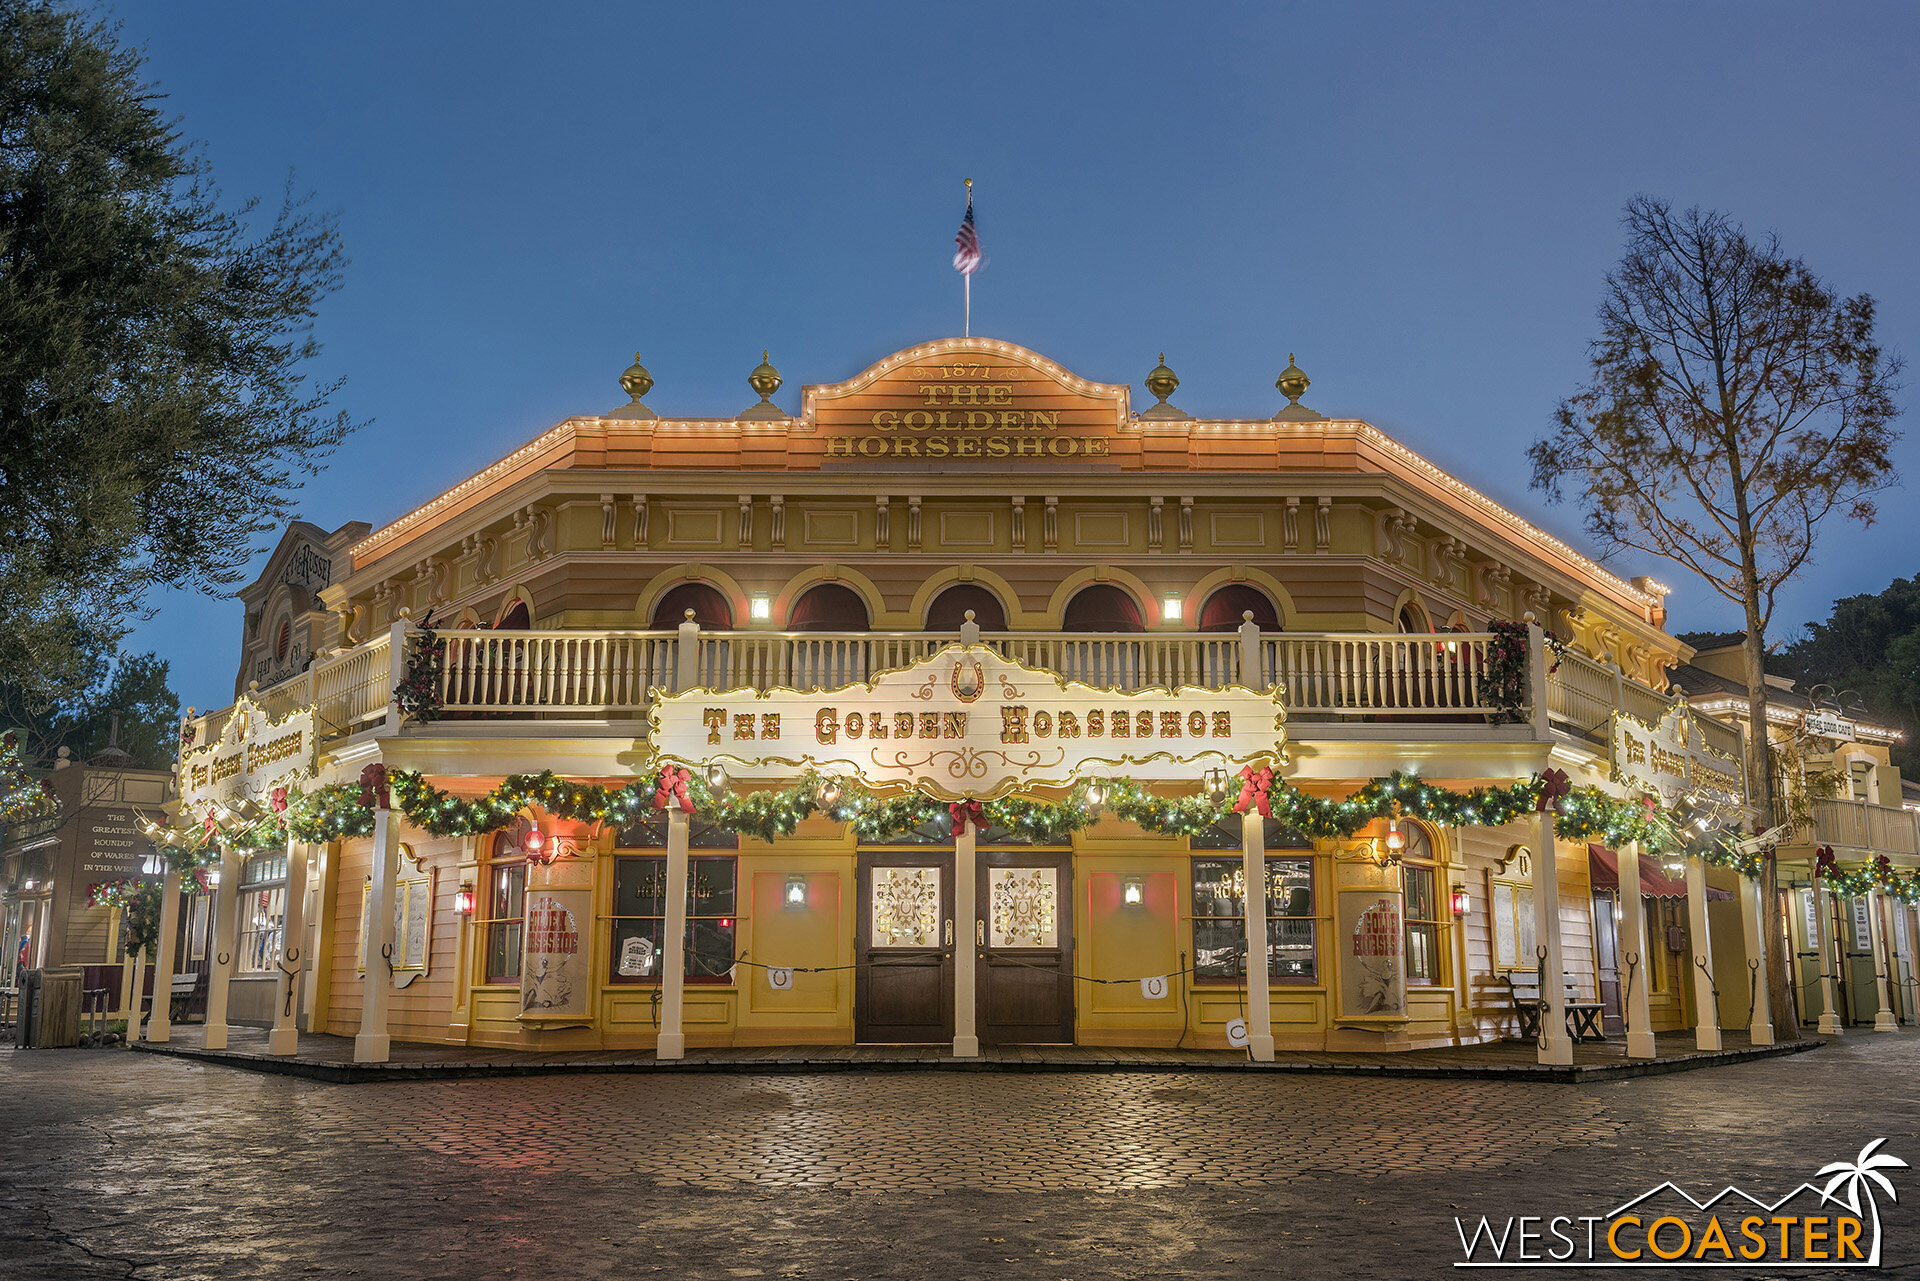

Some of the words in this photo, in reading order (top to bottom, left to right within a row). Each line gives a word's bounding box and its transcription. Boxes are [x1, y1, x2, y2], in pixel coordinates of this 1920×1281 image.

[940, 362, 992, 380] 1871
[918, 384, 1014, 406] THE
[870, 410, 1061, 432] GOLDEN
[823, 435, 1111, 458] HORSESHOE
[703, 708, 780, 745] THE
[813, 707, 967, 745] GOLDEN
[1000, 705, 1232, 744] HORSESHOE
[107, 814, 126, 822] THE
[92, 825, 137, 835] GREATEST
[94, 839, 134, 847] ROUNDUP
[91, 851, 103, 859] OF
[104, 851, 135, 860] WARES
[94, 864, 113, 872] THE
